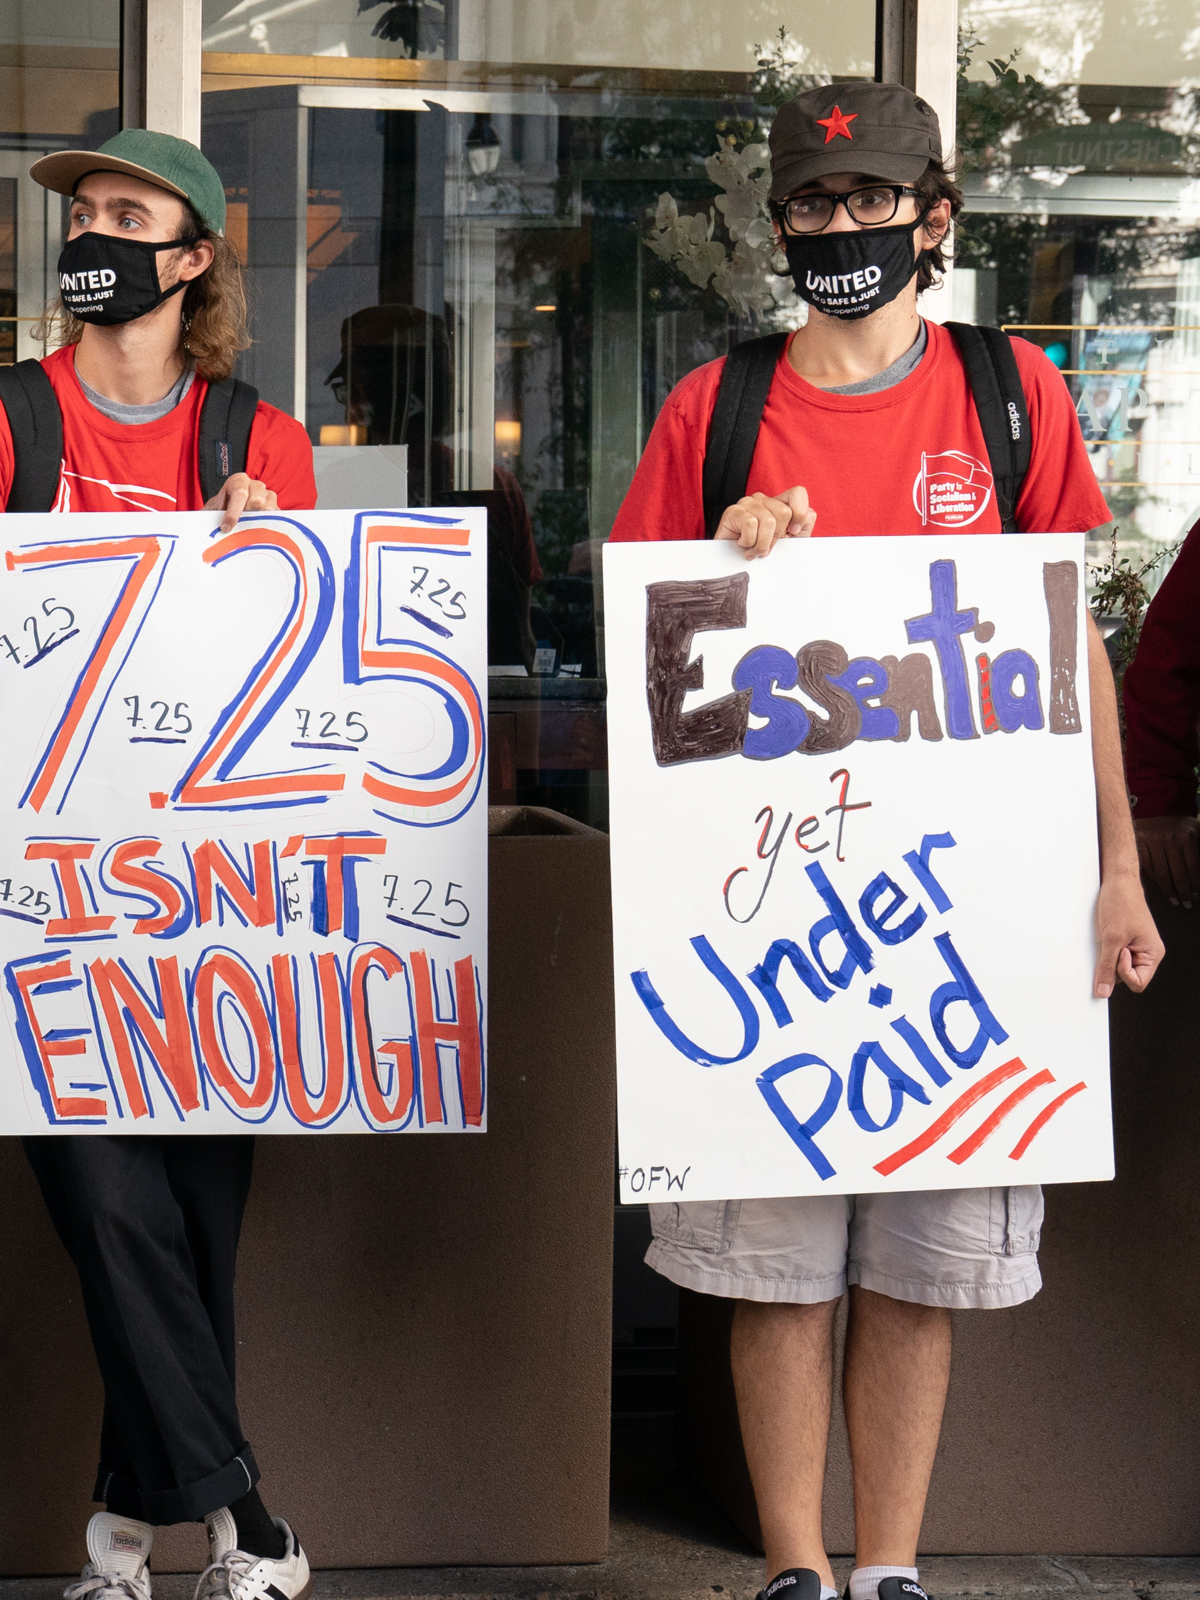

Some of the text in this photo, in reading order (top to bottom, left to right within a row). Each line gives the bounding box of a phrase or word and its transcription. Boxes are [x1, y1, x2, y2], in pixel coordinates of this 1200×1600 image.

[86, 294, 93, 302] &
[93, 289, 114, 301] JUST
[805, 265, 882, 294] UNITED
[826, 297, 849, 306] SAFE
[850, 296, 858, 304] &
[858, 286, 880, 302] JUST
[822, 303, 870, 315] re-opening
[1007, 401, 1021, 440] adidas
[929, 482, 955, 494] Party
[929, 491, 971, 504] Socialism
[930, 503, 975, 515] Liberation
[408, 566, 467, 620] 7.25
[5, 511, 485, 828] 7.25
[645, 559, 1083, 768] Essential
[123, 694, 193, 734] 7.25
[722, 768, 872, 923] yet
[23, 831, 388, 944] ISN'T
[283, 872, 303, 922] 7.25
[382, 874, 471, 927] 7.25
[629, 831, 957, 1068] Under
[3, 941, 486, 1134] ENOUGH
[619, 1165, 691, 1193] #OFW
